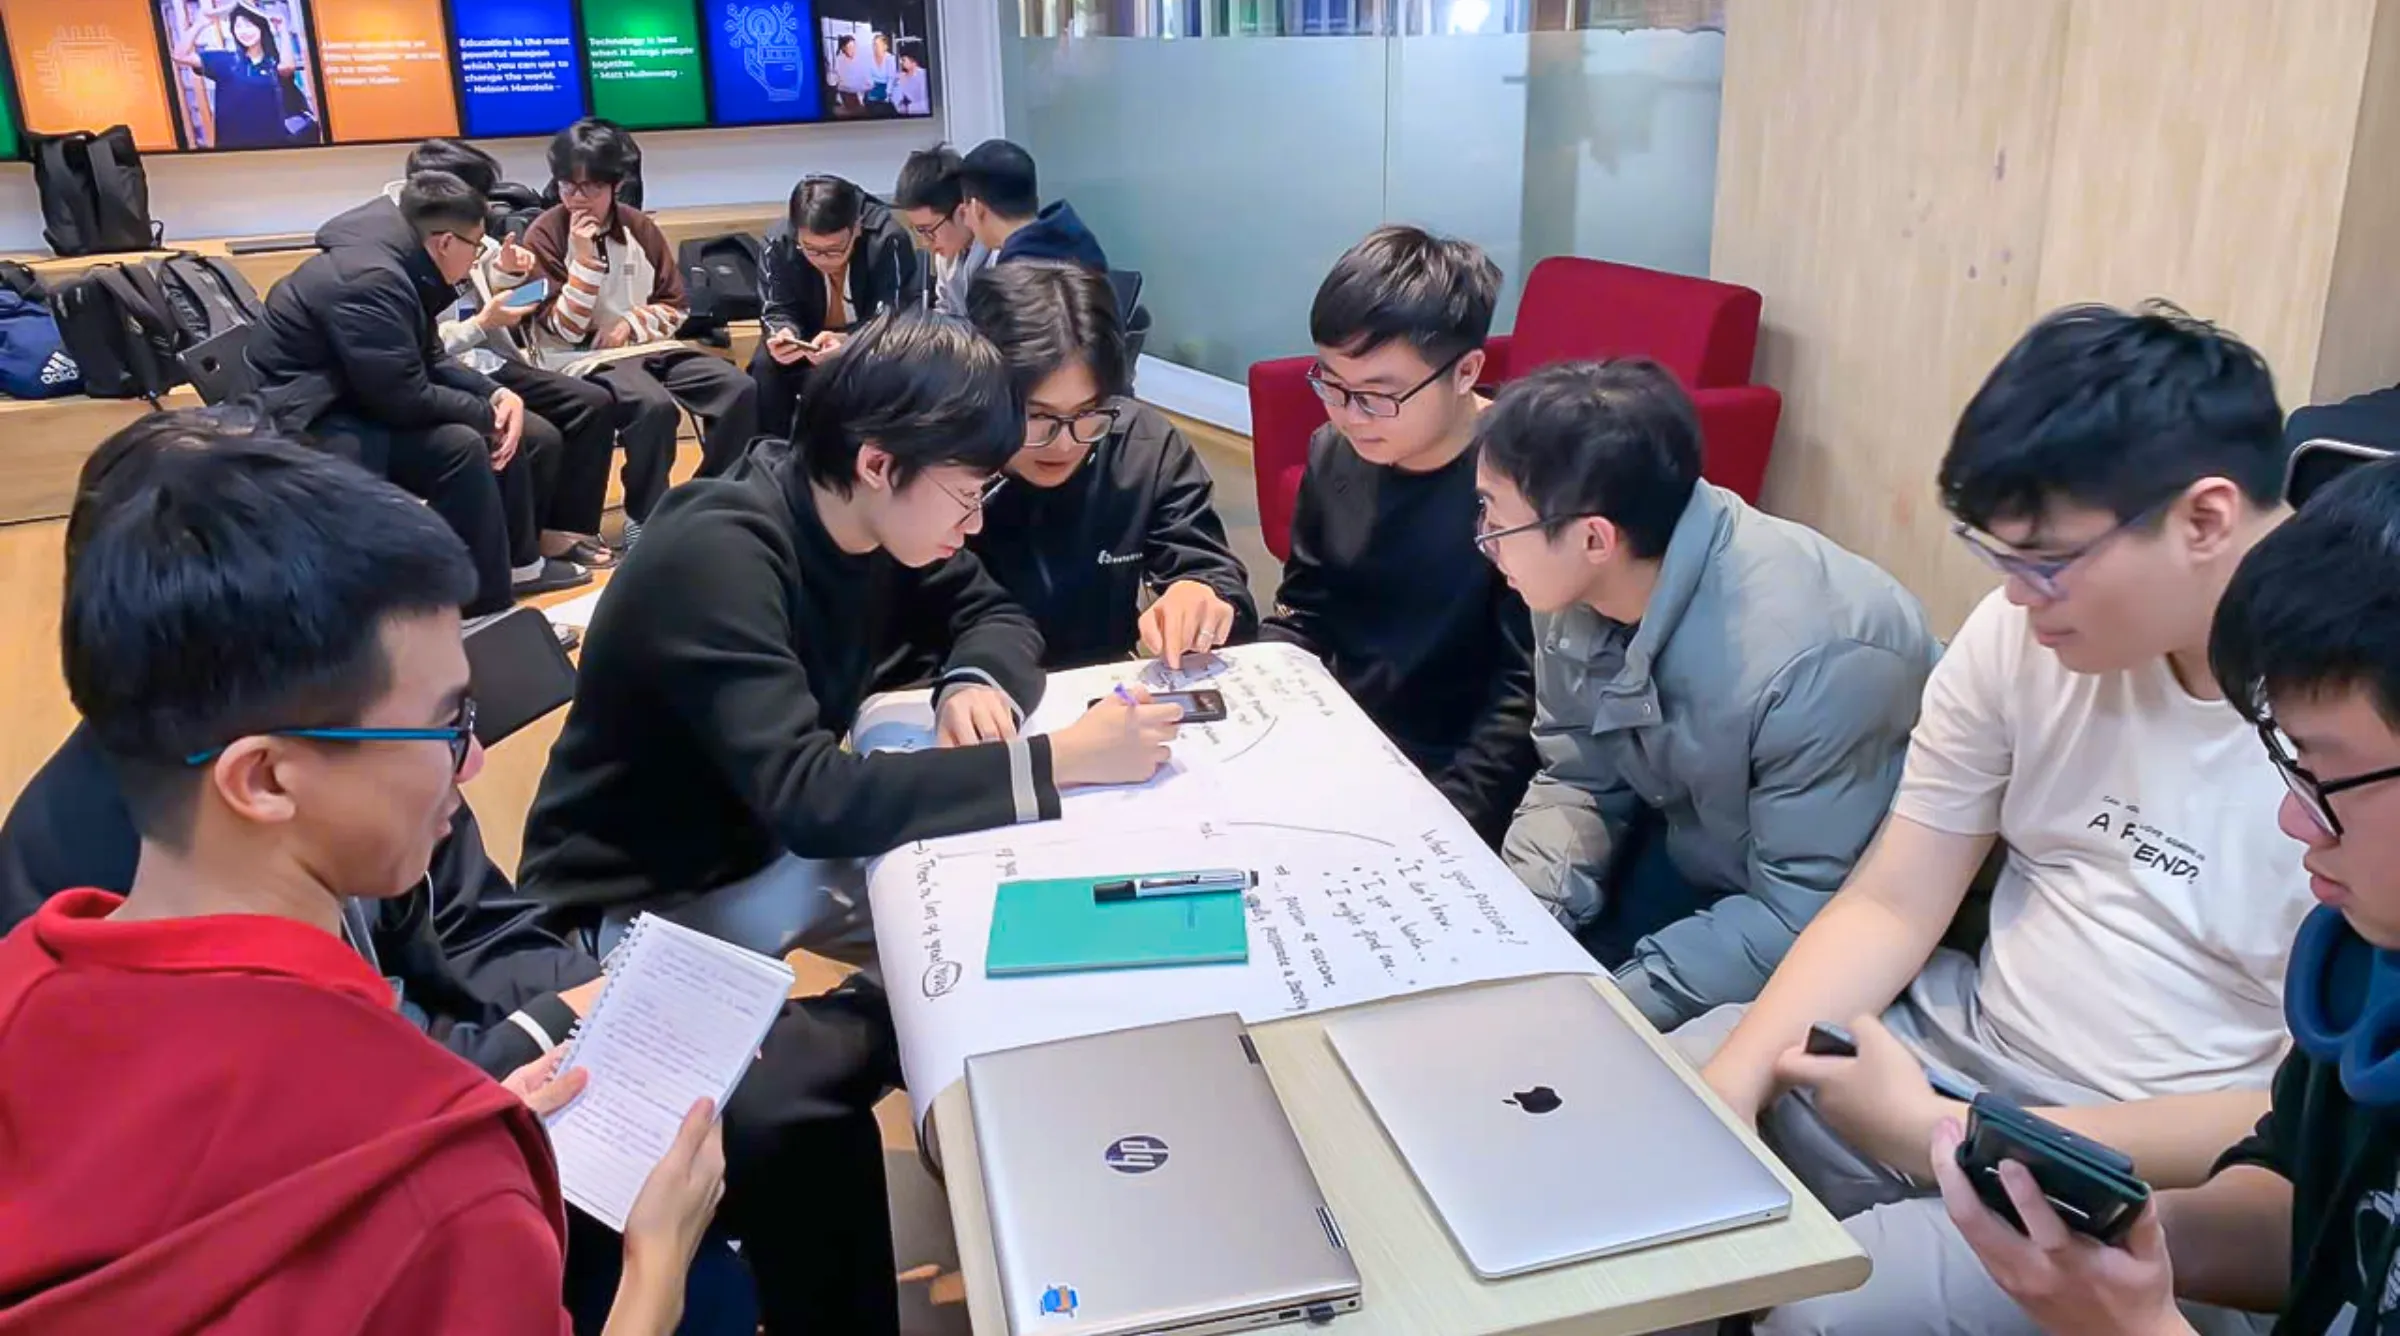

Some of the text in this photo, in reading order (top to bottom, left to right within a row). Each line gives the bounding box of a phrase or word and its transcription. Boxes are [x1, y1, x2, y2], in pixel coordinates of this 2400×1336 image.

[459, 37, 570, 48] Education is the most
[588, 37, 645, 47] Technology
[656, 36, 678, 44] best
[461, 50, 550, 61] powerful weapon
[590, 49, 619, 58] when
[629, 47, 660, 58] brings
[661, 46, 694, 57] people
[463, 60, 570, 72] which you can use to
[592, 60, 637, 70] together.
[464, 70, 556, 83] change the world.
[473, 84, 509, 94] Nelson
[510, 82, 555, 93] Mandela
[2086, 812, 2110, 833] A
[1106, 1139, 1168, 1168] hp
